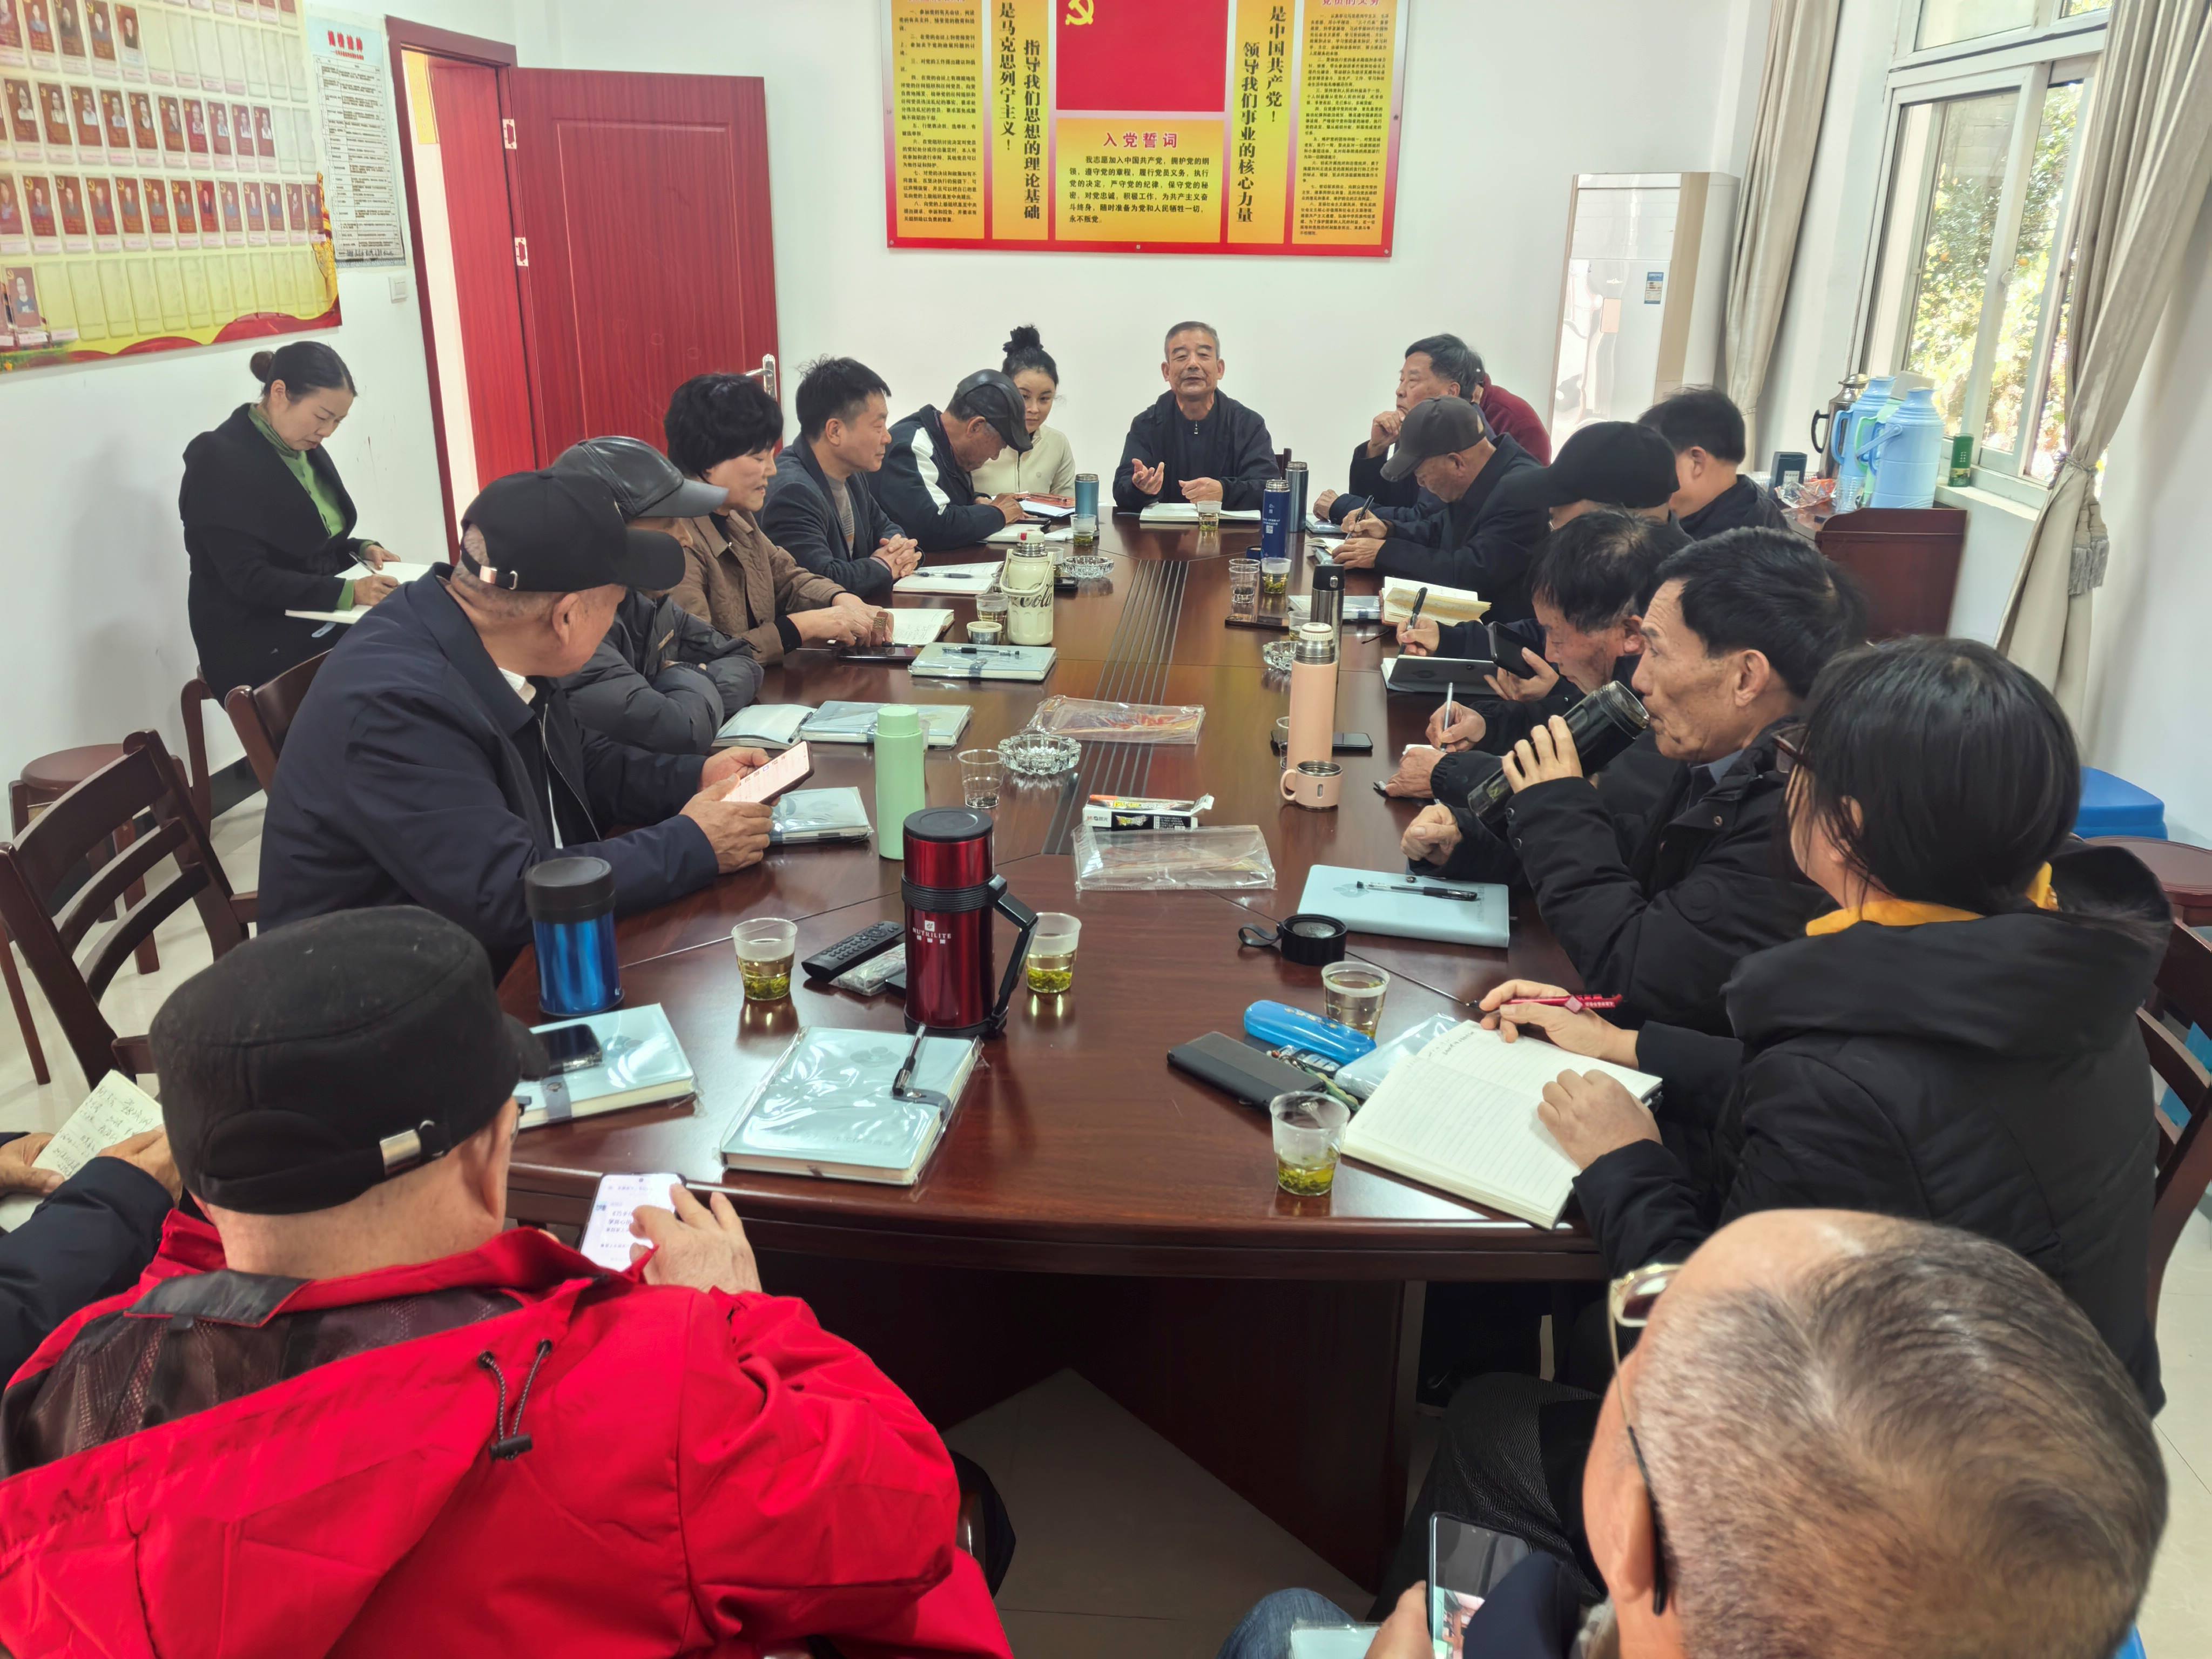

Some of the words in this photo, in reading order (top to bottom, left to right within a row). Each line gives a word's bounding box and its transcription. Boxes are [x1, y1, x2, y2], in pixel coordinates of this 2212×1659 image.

[1266, 5, 1286, 122] 是中国共产党！
[999, 2, 1016, 150] 是马克思列宁主义！
[1024, 39, 1041, 219] 指导我们思想的理论基础
[1236, 42, 1260, 222] 领导我们事业的核心力量
[1103, 132, 1177, 148] 入党誓词
[1085, 156, 1210, 165] 我志愿加入中国共产党，拥护党的纲
[1069, 167, 1209, 178] 领，遵守党的章程，履行党员义务，执行
[1069, 180, 1209, 190] 党的决定，严守党的纪律，保守党的秘
[913, 927, 952, 939] NUTRILITE
